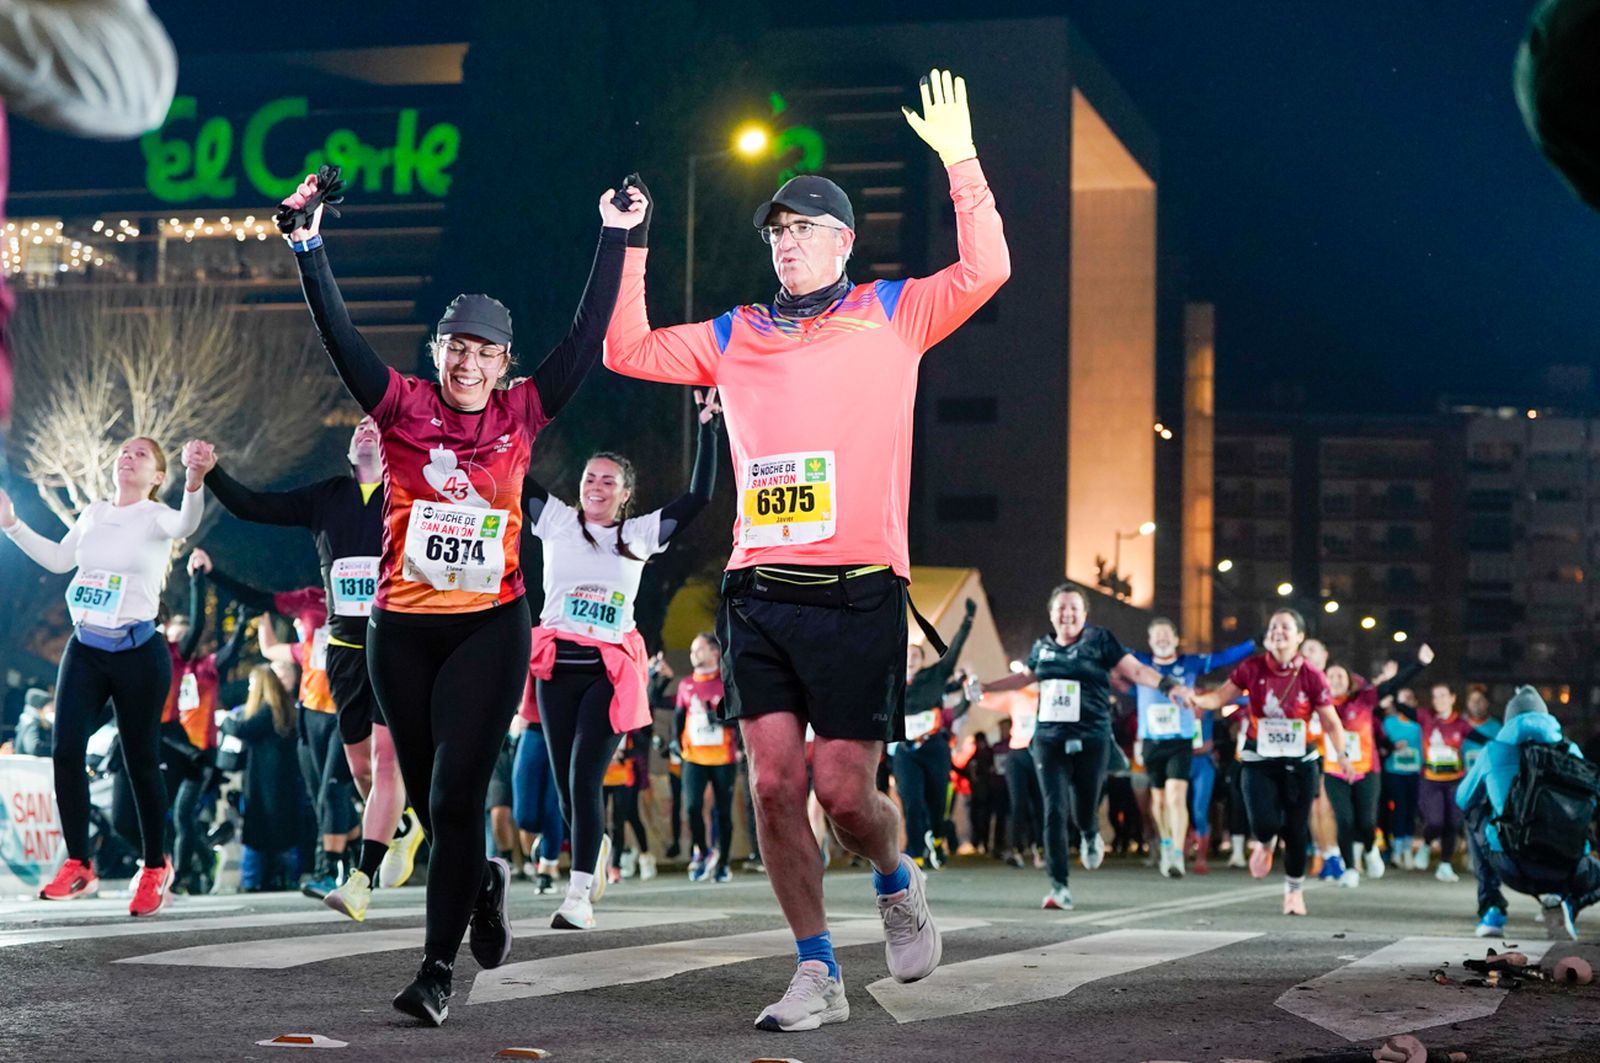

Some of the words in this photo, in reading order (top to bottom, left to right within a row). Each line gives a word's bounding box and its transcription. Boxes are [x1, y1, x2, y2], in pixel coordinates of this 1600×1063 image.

[141, 96, 237, 202] El
[760, 465, 783, 476] NOCHE
[785, 463, 796, 473] DE
[443, 477, 469, 500] 43
[751, 478, 768, 489] SAN
[757, 486, 815, 516] 6375
[420, 521, 441, 533] SAN
[433, 512, 464, 525] NOCHE
[464, 516, 477, 527] DE
[426, 534, 486, 566] 6374
[74, 586, 112, 606] 9557
[339, 578, 375, 596] 1318
[571, 599, 616, 624] 12418
[1268, 732, 1296, 743] 5547
[13, 792, 53, 824] SAN
